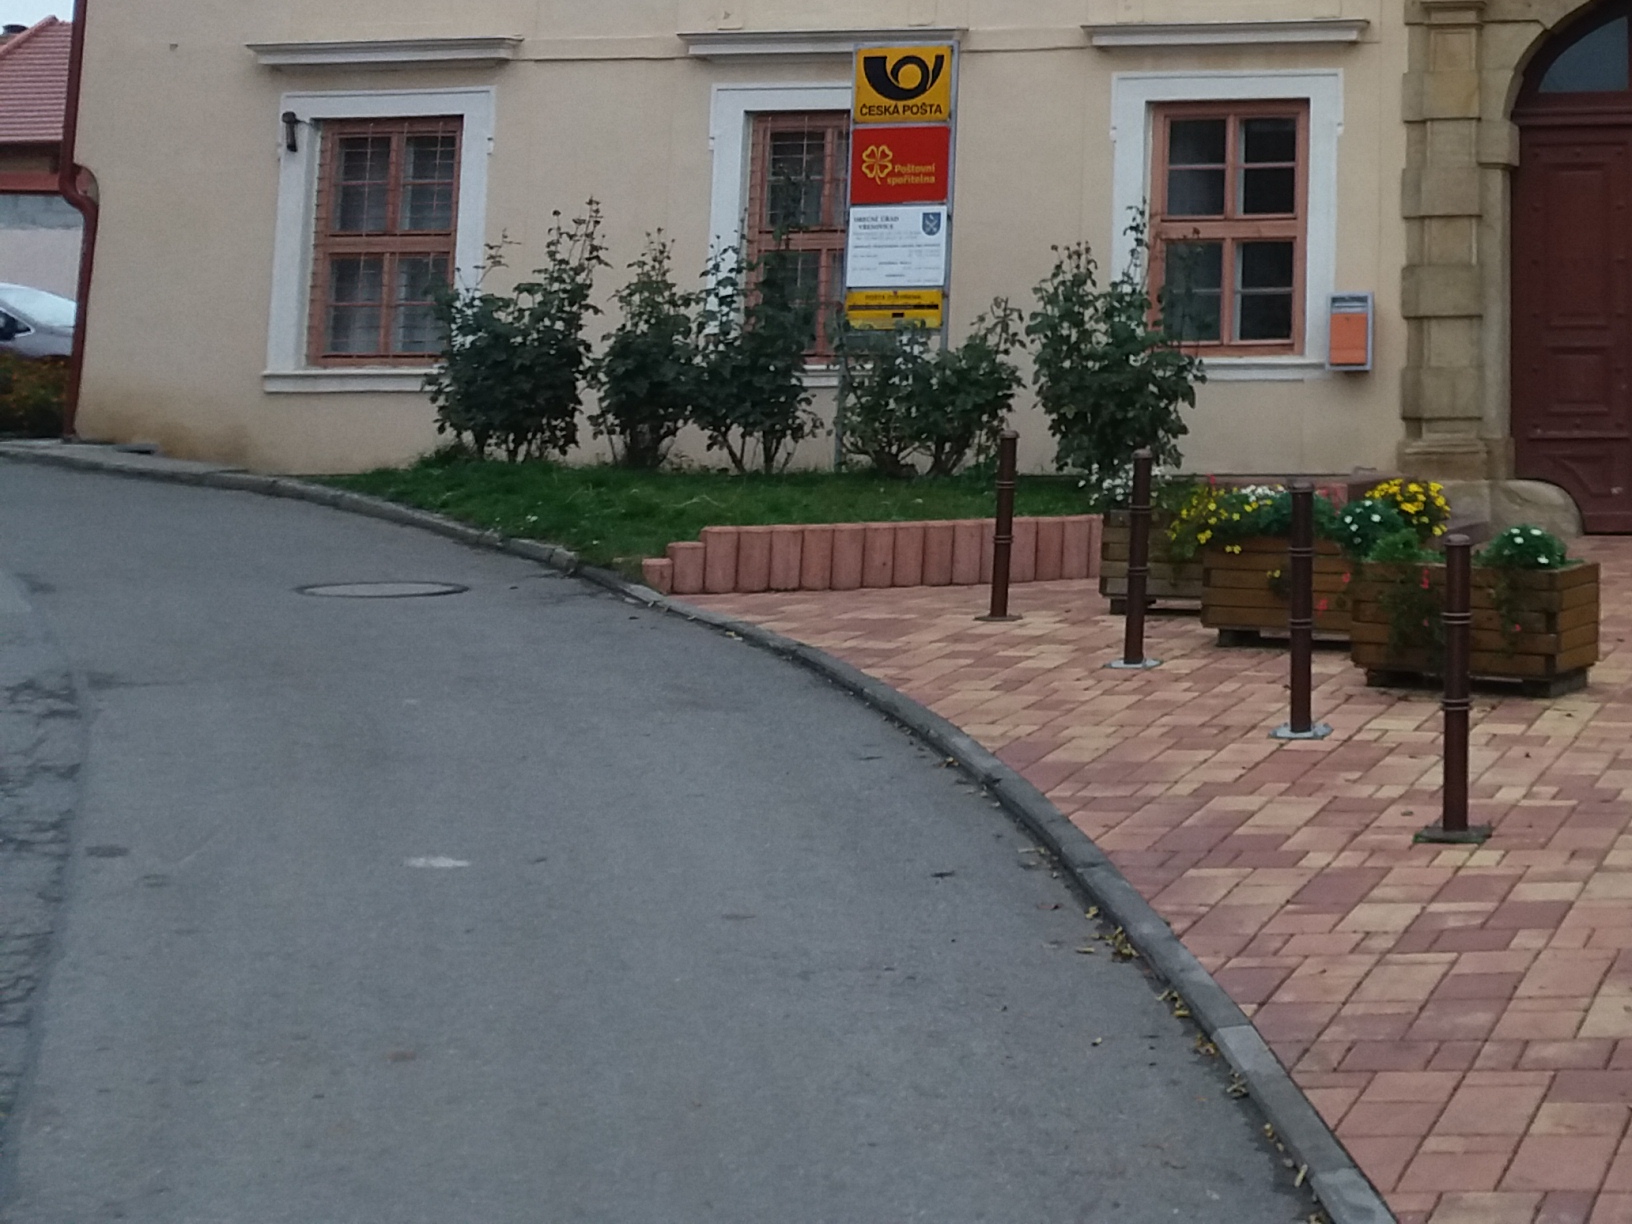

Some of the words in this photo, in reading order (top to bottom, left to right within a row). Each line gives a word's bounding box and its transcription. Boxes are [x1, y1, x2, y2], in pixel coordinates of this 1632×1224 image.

[860, 103, 900, 116] ČESKÁ
[902, 102, 943, 115] POŠTA
[895, 162, 936, 173] Poštovní
[887, 174, 936, 187] spořitelna
